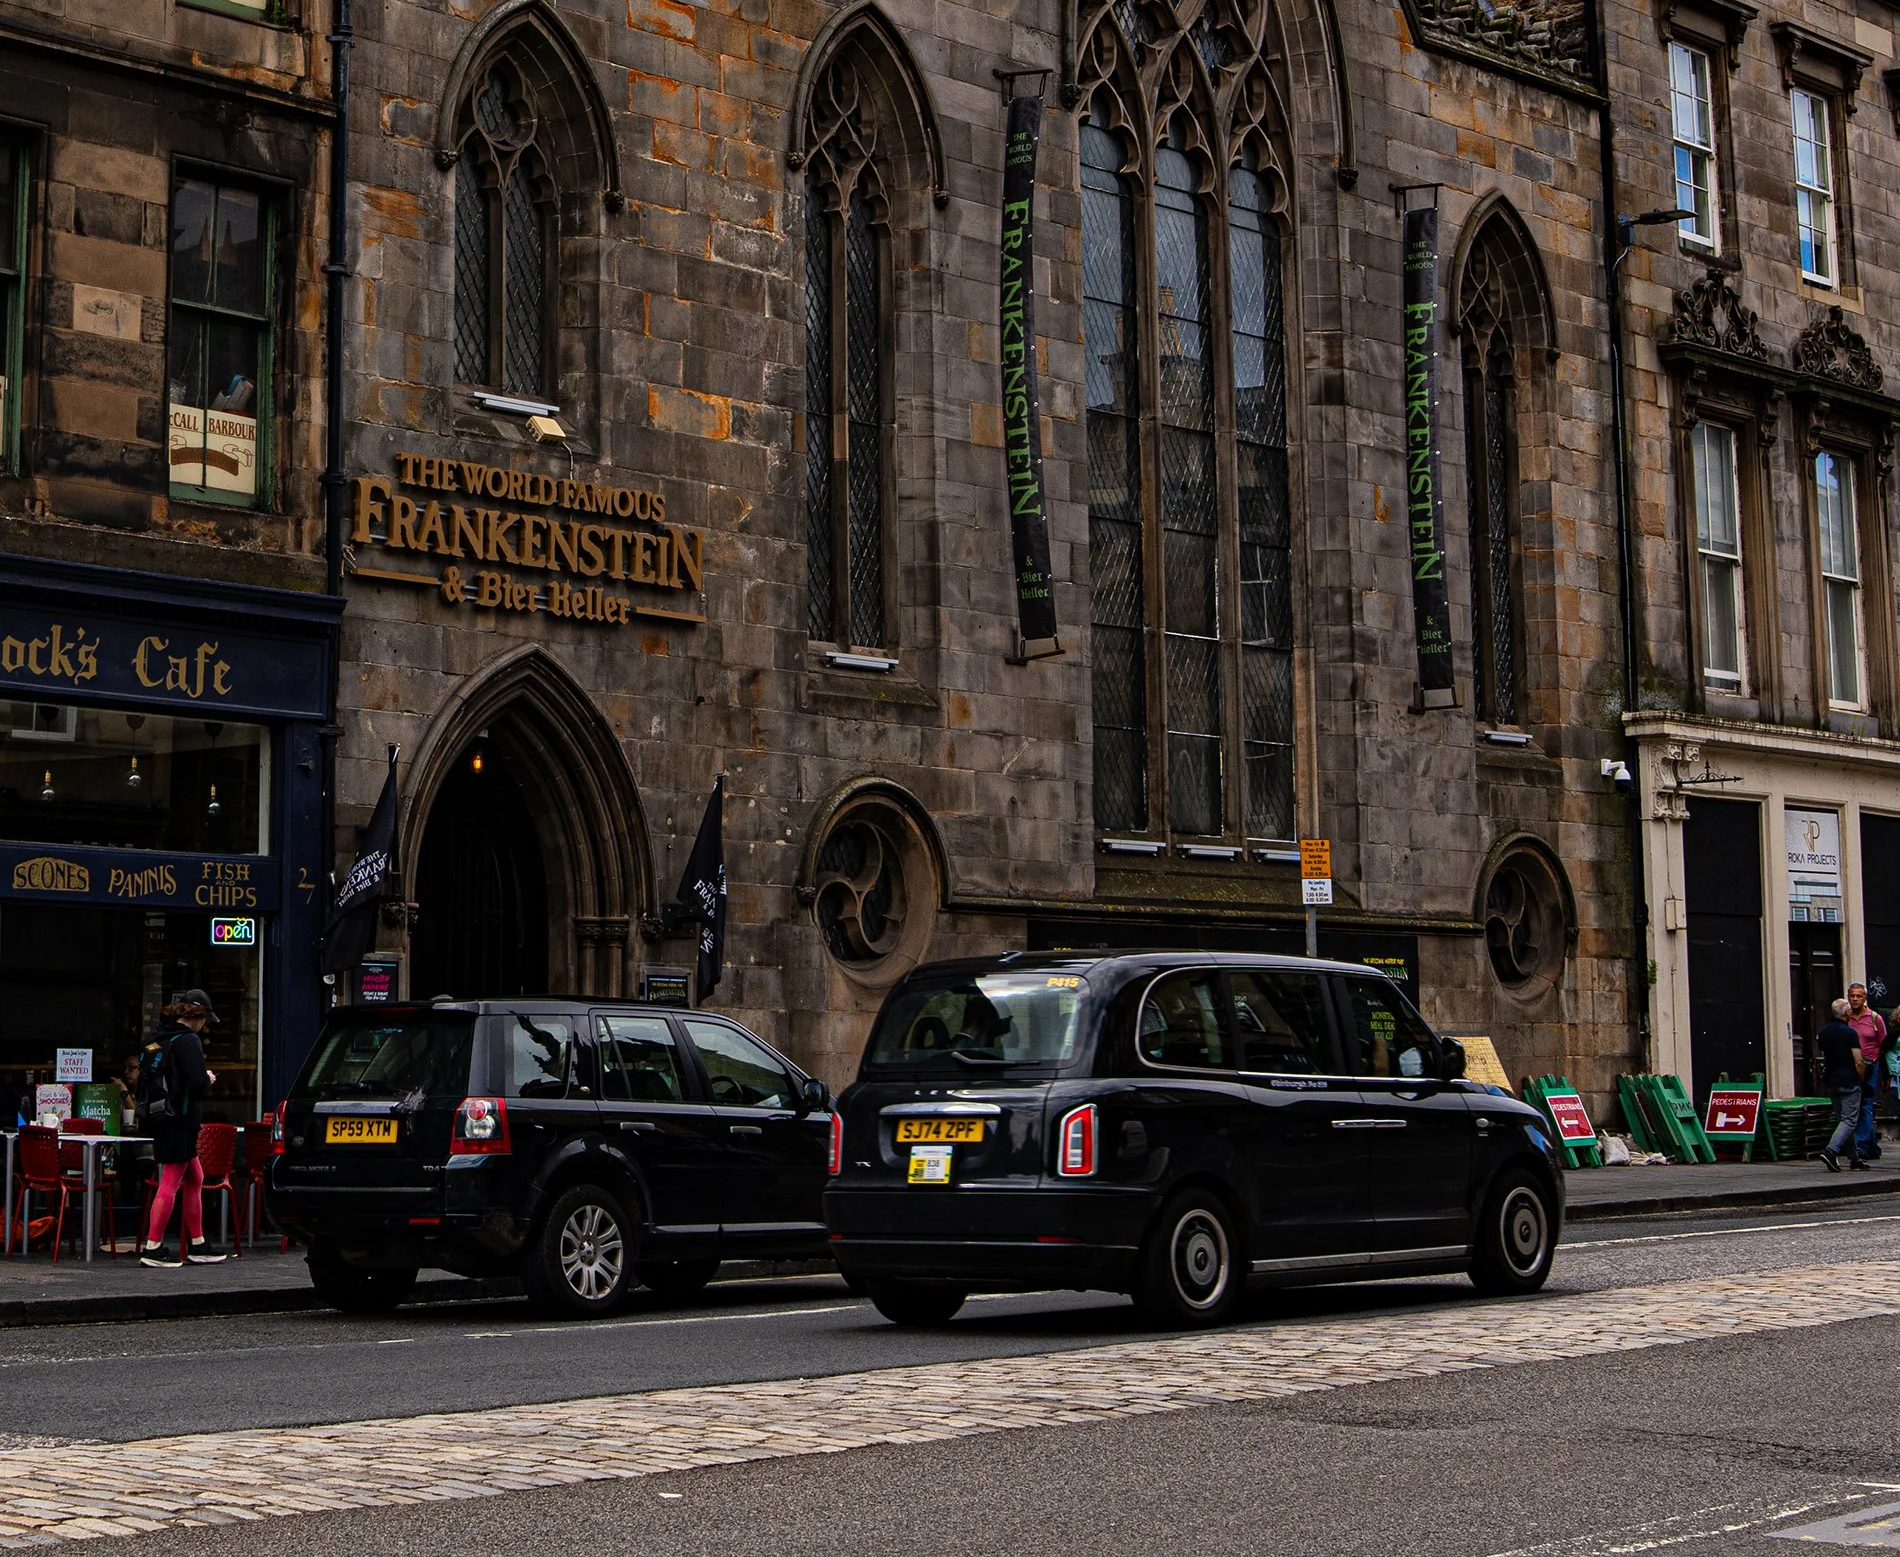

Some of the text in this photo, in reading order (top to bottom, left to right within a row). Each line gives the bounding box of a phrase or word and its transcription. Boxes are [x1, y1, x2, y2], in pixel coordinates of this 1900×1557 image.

[1013, 131, 1028, 142] THE
[1002, 197, 1042, 517] FRANKENSTEIN
[208, 417, 256, 439] BARBOUR
[1406, 301, 1443, 582] FRANKENSTEIN
[395, 452, 668, 523] THE WORLD FAMOUS
[351, 476, 706, 592] FRANKENSTEIN
[1025, 554, 1033, 567] &
[1021, 572, 1043, 583] Bier
[440, 564, 633, 626] & Bier Keller
[1426, 614, 1434, 626] &
[1421, 629, 1443, 640] Bier
[131, 635, 233, 699] Cafe
[1788, 852, 1837, 866] ROKA PROJECTS
[15, 860, 87, 889] SCONES
[202, 862, 251, 882] FISH
[108, 864, 177, 898] PANINIS
[194, 884, 257, 908] CHIPS
[214, 920, 252, 942] open
[59, 1066, 89, 1075] WANTED
[64, 1058, 84, 1066] STAFF
[81, 1104, 111, 1116] Matcha
[1551, 1103, 1582, 1111] PEDESTRIANS
[1711, 1098, 1757, 1106] PEDESTRIANS
[332, 1121, 392, 1137] SP59 XTM
[903, 1122, 977, 1139] SJ74 ZPF
